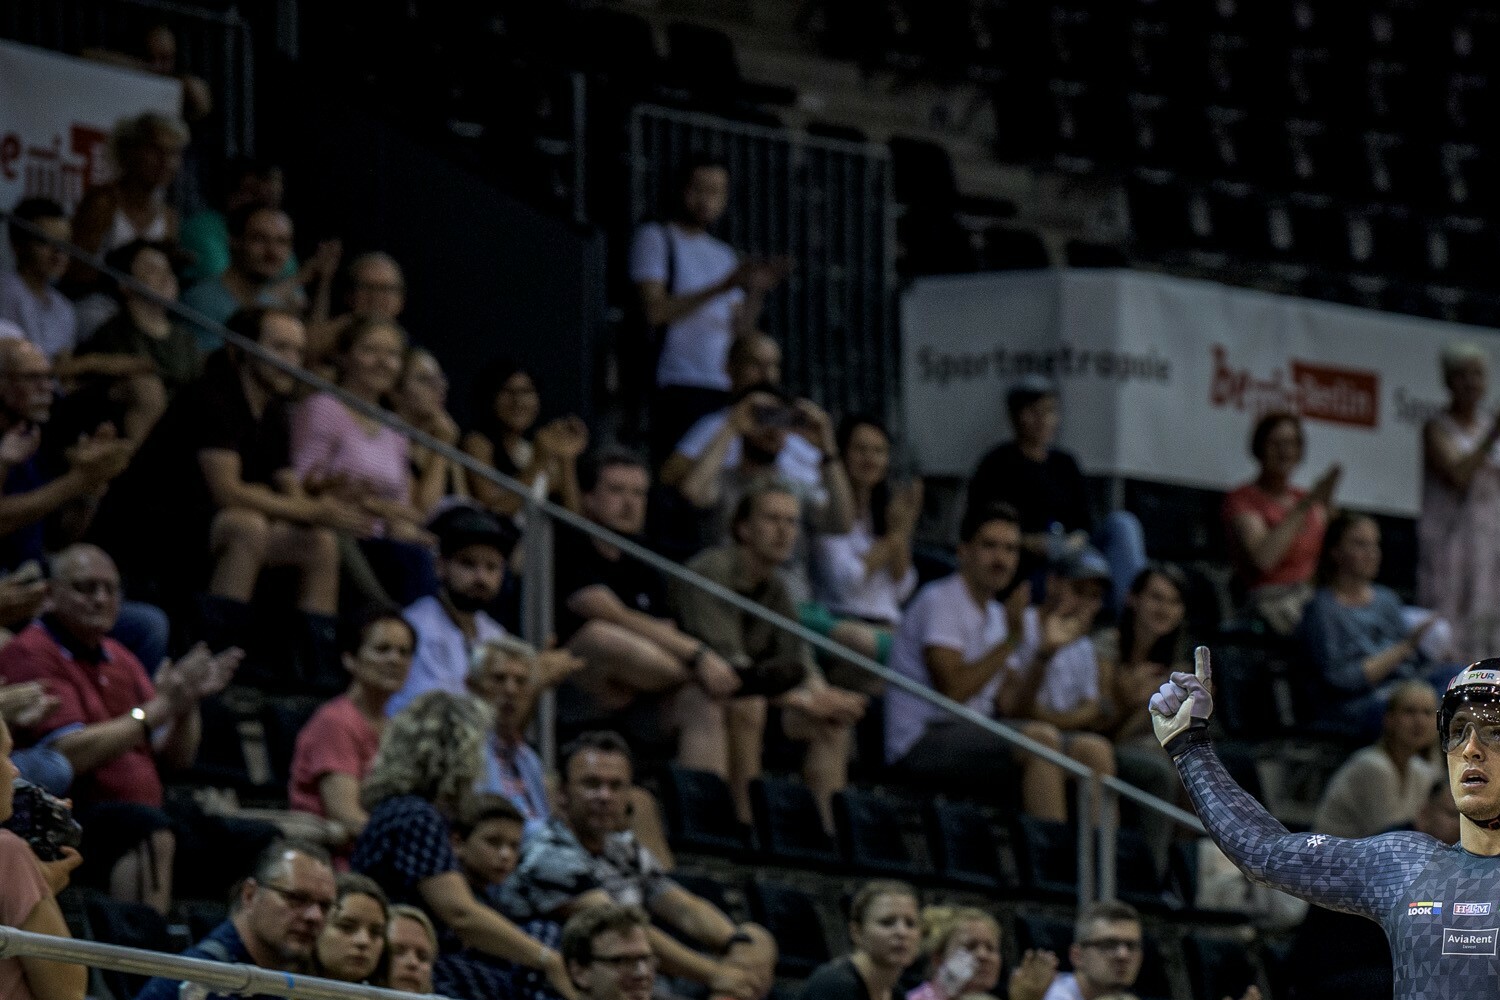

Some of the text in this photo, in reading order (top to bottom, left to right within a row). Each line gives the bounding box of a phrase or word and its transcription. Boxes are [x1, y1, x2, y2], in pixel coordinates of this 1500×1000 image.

[1408, 906, 1432, 915] LOOK
[1455, 903, 1489, 914] HTM
[1447, 933, 1493, 945] AviaRent
